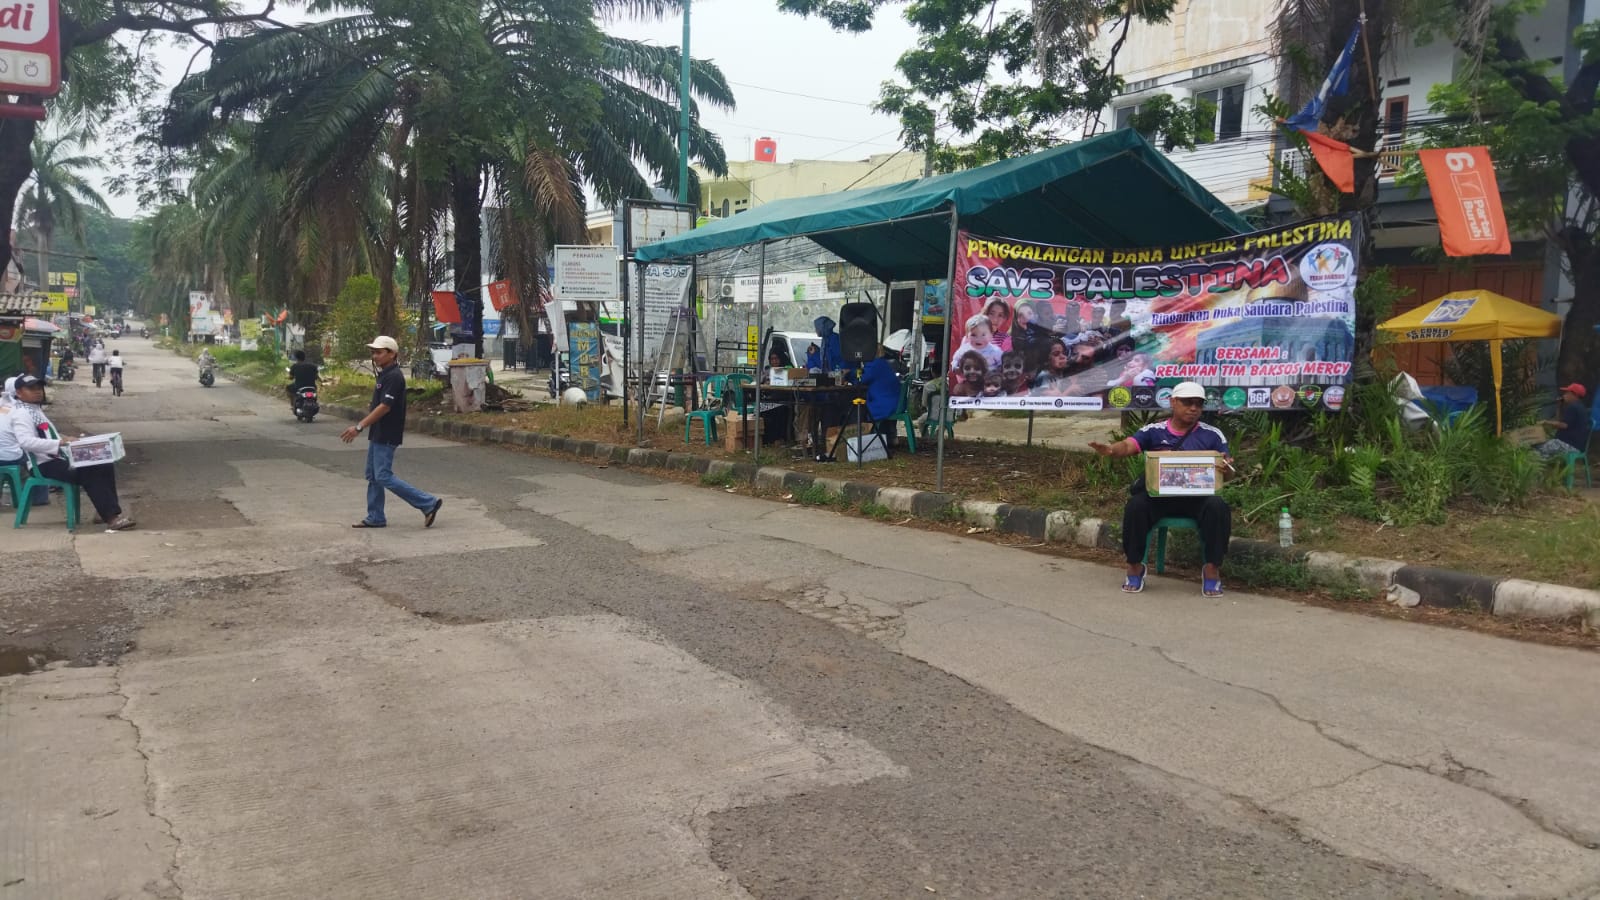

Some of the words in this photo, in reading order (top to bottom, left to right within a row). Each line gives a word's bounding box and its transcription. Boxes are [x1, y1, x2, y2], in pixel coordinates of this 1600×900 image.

[1445, 152, 1475, 172] 6
[1463, 200, 1481, 237] Buruh
[1473, 199, 1491, 237] Partai
[967, 239, 1104, 264] PENGGALANGAN
[1112, 249, 1164, 264] DANA
[1170, 239, 1237, 260] UNTUK
[1244, 219, 1352, 250] PALESTINA
[662, 266, 688, 278] 379
[966, 266, 1054, 299] SAVE
[1063, 256, 1291, 300] PALESTINA
[1151, 308, 1209, 326] Ringankan
[1213, 306, 1241, 320] Duka
[1243, 302, 1292, 317] Saudara
[1295, 298, 1349, 316] Palestina
[1215, 347, 1279, 361] BERSAMA
[1156, 364, 1217, 378] RELAWAN
[1221, 365, 1246, 377] TIM
[1250, 363, 1299, 377] BAKSOS
[1302, 362, 1351, 376] MERCY
[1250, 393, 1269, 405] BGP
